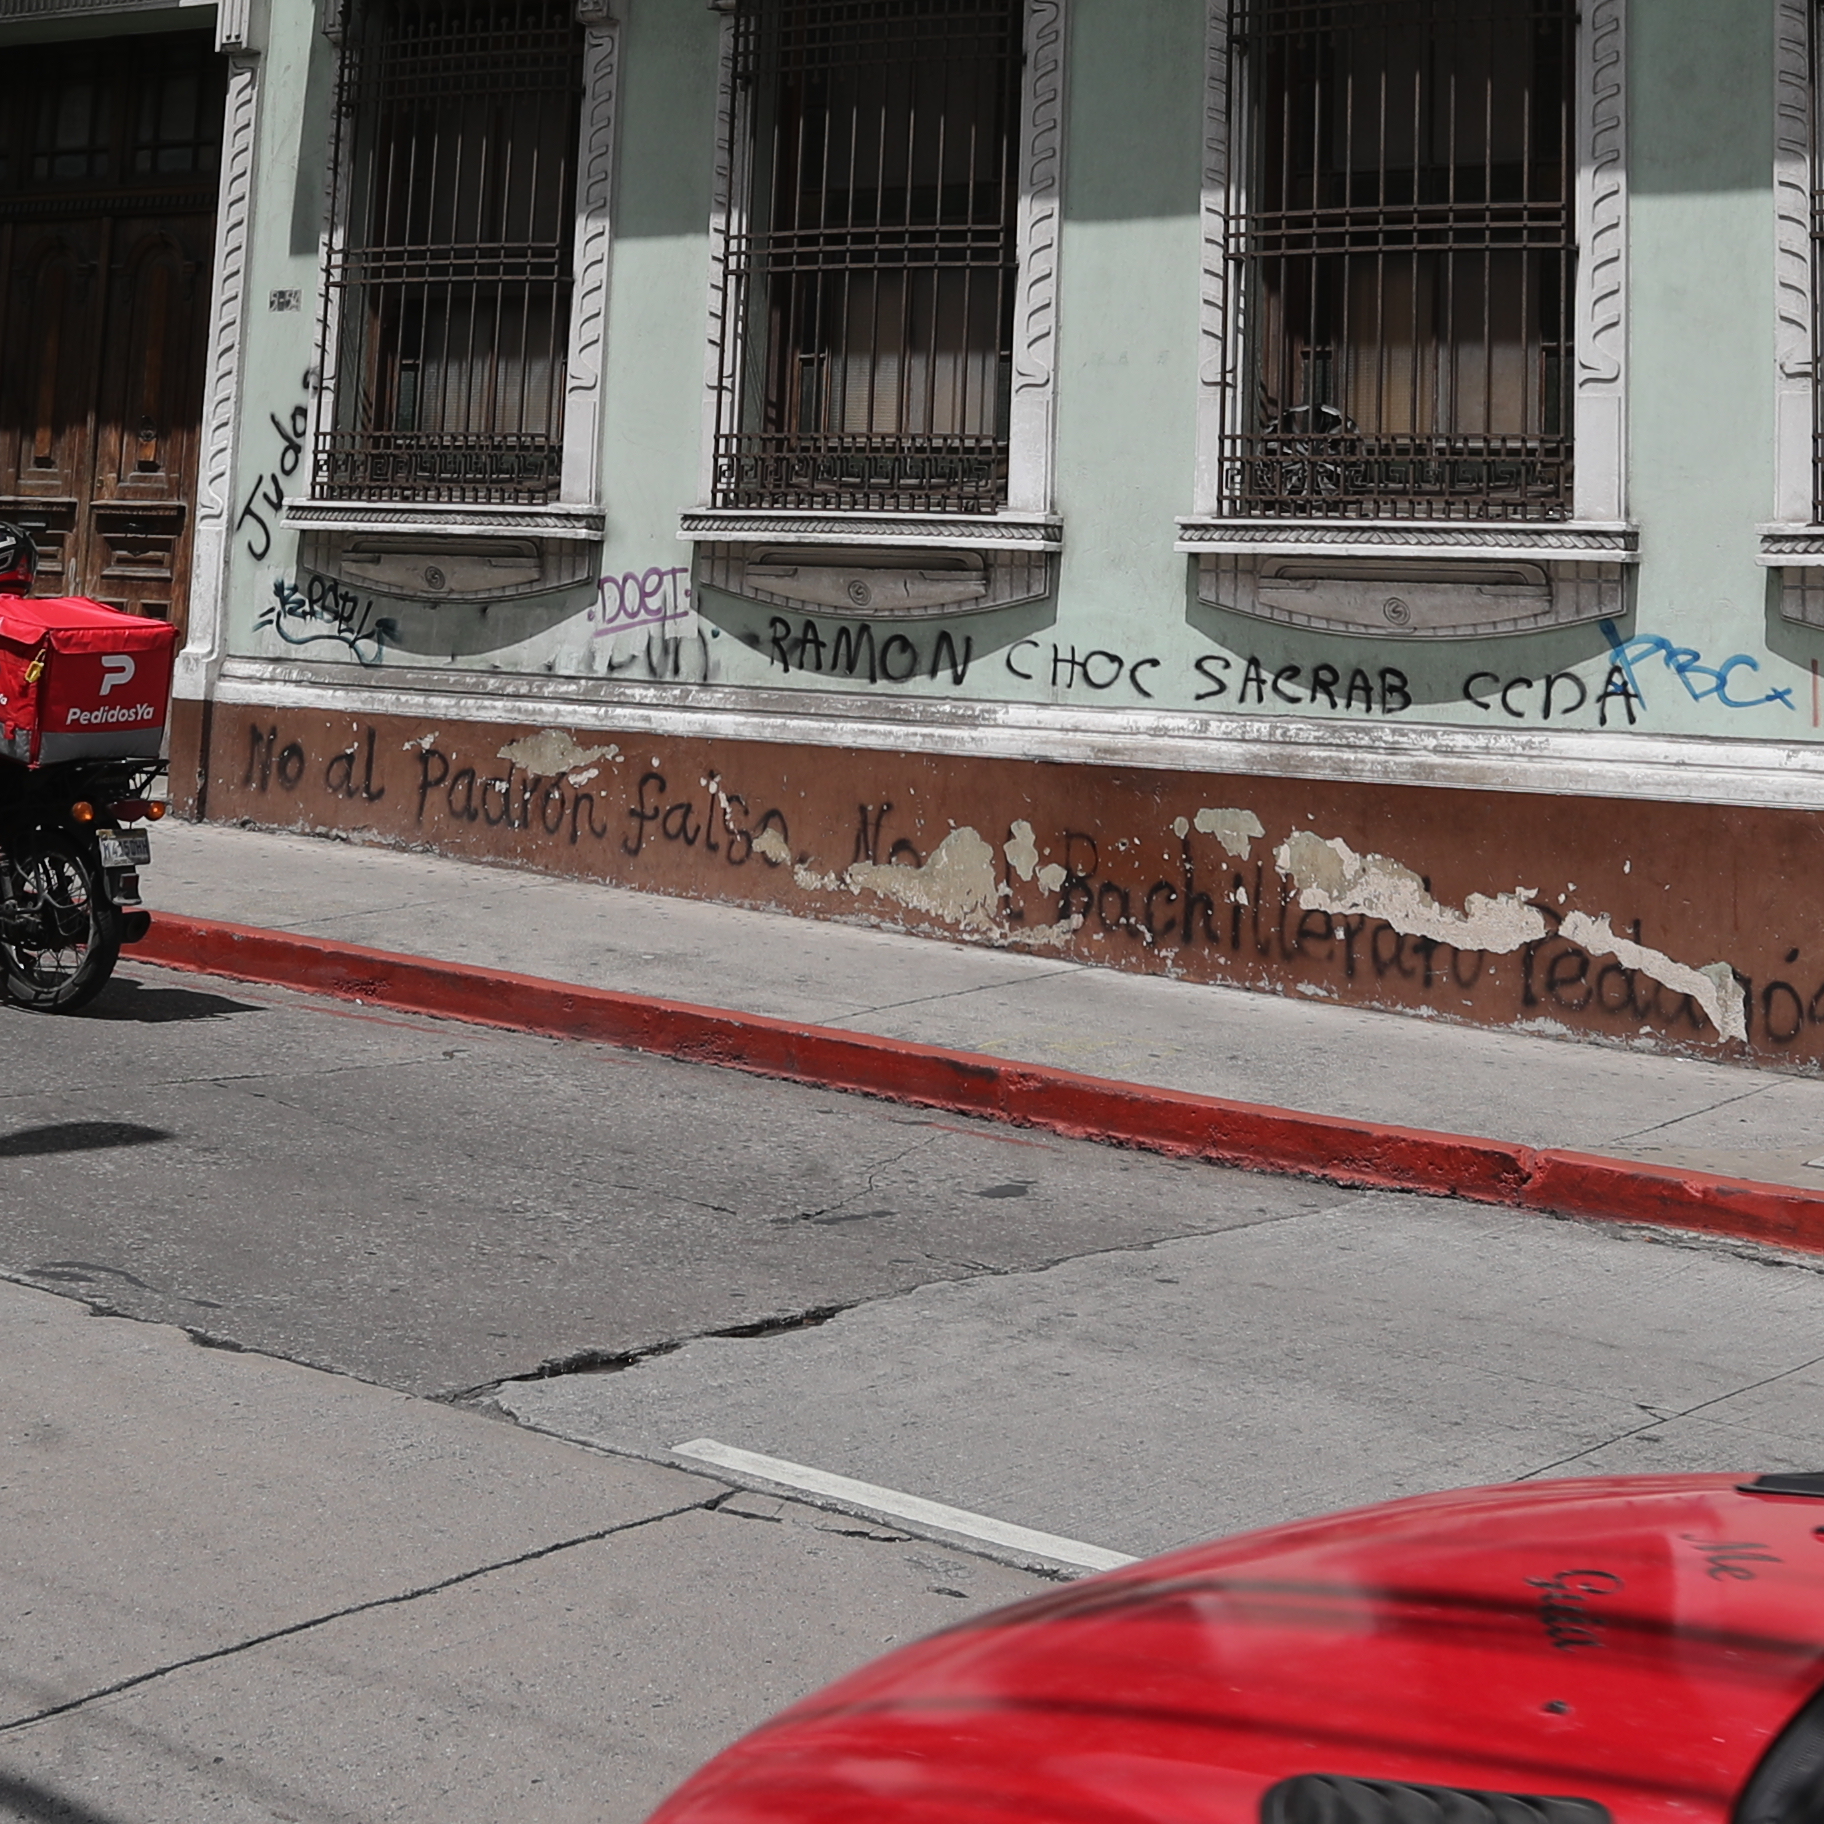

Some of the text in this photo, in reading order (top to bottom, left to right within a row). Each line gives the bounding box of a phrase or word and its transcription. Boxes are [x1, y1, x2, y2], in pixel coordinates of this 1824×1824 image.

[768, 616, 973, 686] RAMON
[1006, 640, 1161, 699] CHOC
[65, 702, 154, 726] PedidosYa
[244, 722, 305, 794] No
[326, 726, 386, 802] al
[1679, 1533, 1784, 1582] Me
